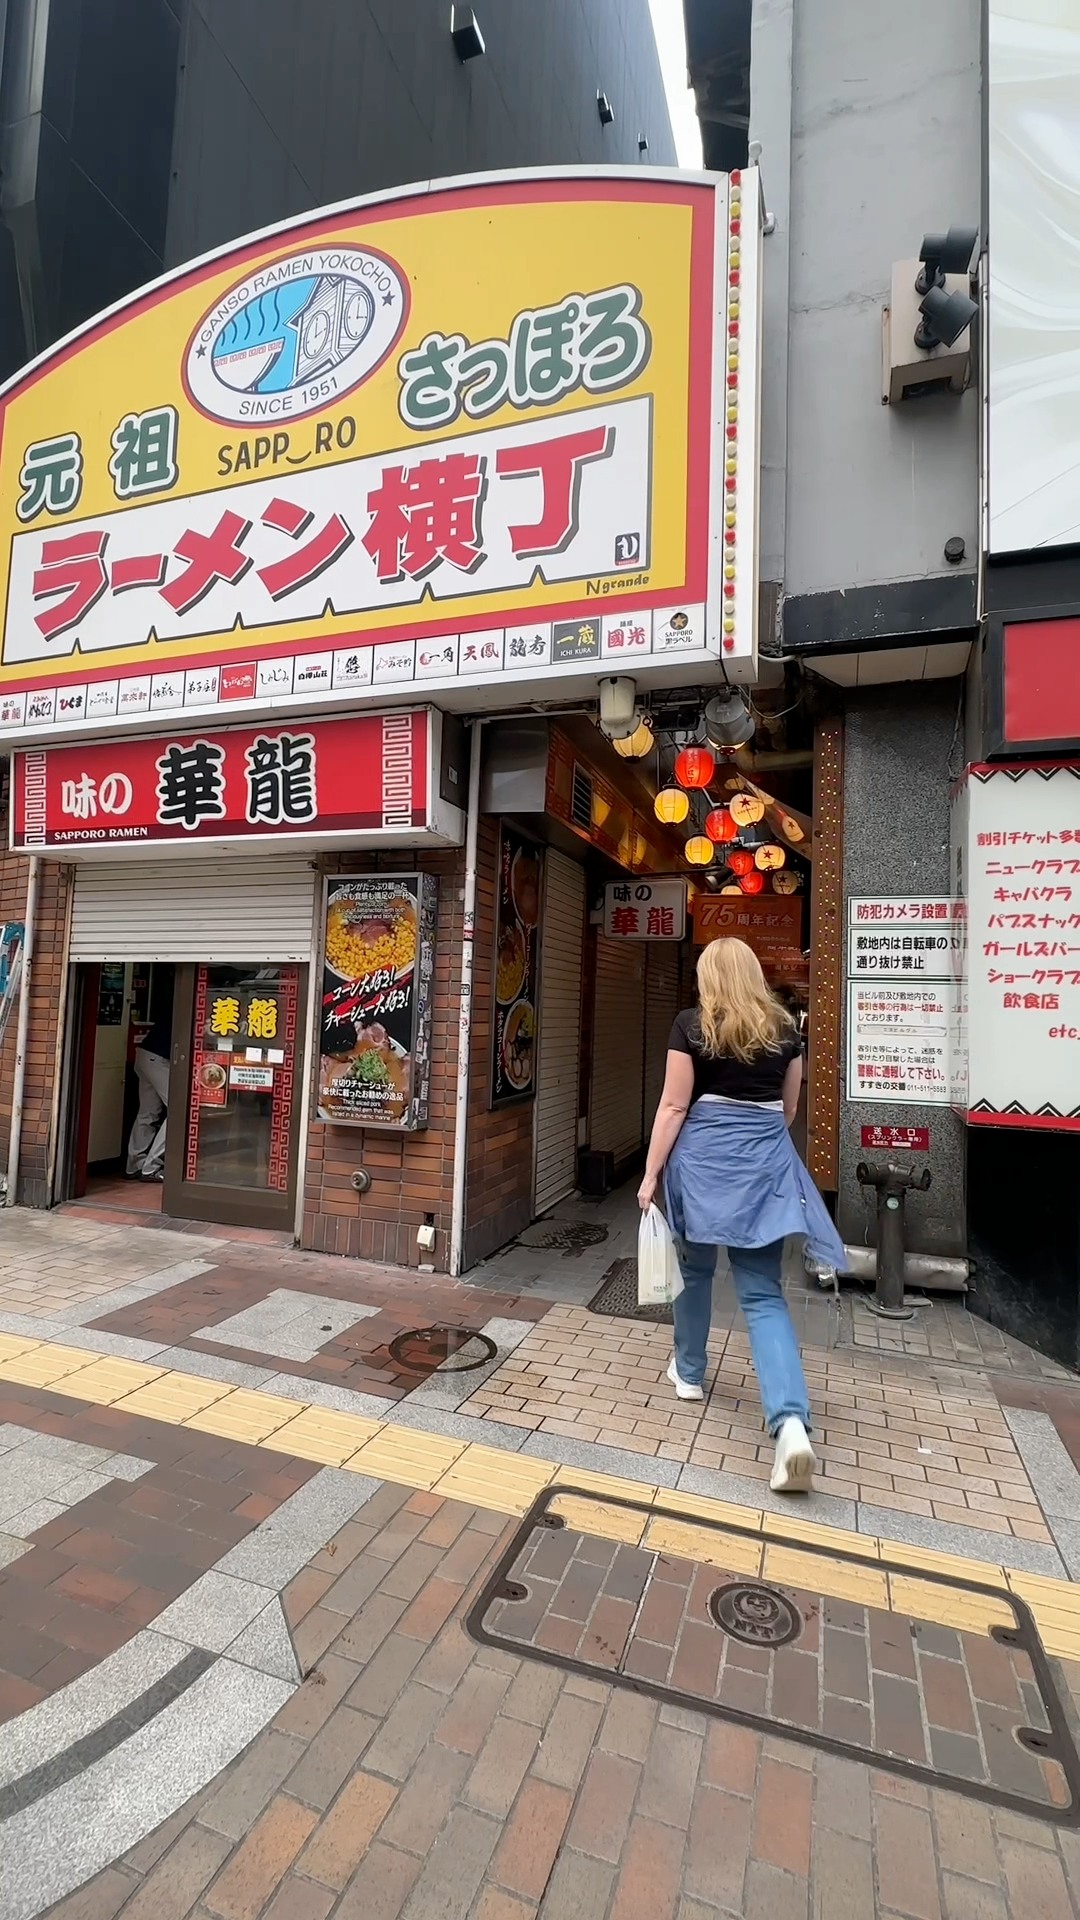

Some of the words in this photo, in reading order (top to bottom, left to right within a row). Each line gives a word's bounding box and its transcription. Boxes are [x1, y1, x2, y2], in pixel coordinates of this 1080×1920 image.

[200, 287, 250, 343] GANSO
[253, 257, 313, 292] RAMEN
[319, 254, 391, 292] YOKOCHO
[398, 284, 650, 429] さっぽろ
[239, 395, 293, 415] SINCE
[301, 376, 339, 404] 1951
[32, 425, 615, 641] ラーメン横丁
[556, 624, 595, 647] 一蔵
[608, 627, 646, 649] 國光
[665, 629, 693, 638] SAPPORO
[560, 649, 573, 657] ICHI
[61, 771, 133, 819] 味の
[155, 732, 317, 830] 華龍
[54, 829, 106, 840] SAPPORO
[109, 827, 148, 837] RAMEN
[613, 884, 652, 902] 味の
[993, 886, 1073, 902] キャバクラ
[701, 903, 794, 927] 75周年記念
[856, 903, 947, 919] 防犯カメラ設置
[610, 906, 674, 936] 華龍
[856, 936, 948, 950] 敷地内は自転車の
[856, 955, 924, 969] 通り抜け禁止
[1003, 992, 1059, 1009] 飲食店
[210, 995, 279, 1039] 華龍
[858, 1013, 903, 1022] しております。
[857, 1064, 945, 1081] 警察に通報して下さい。
[873, 1126, 915, 1137] 送水口
